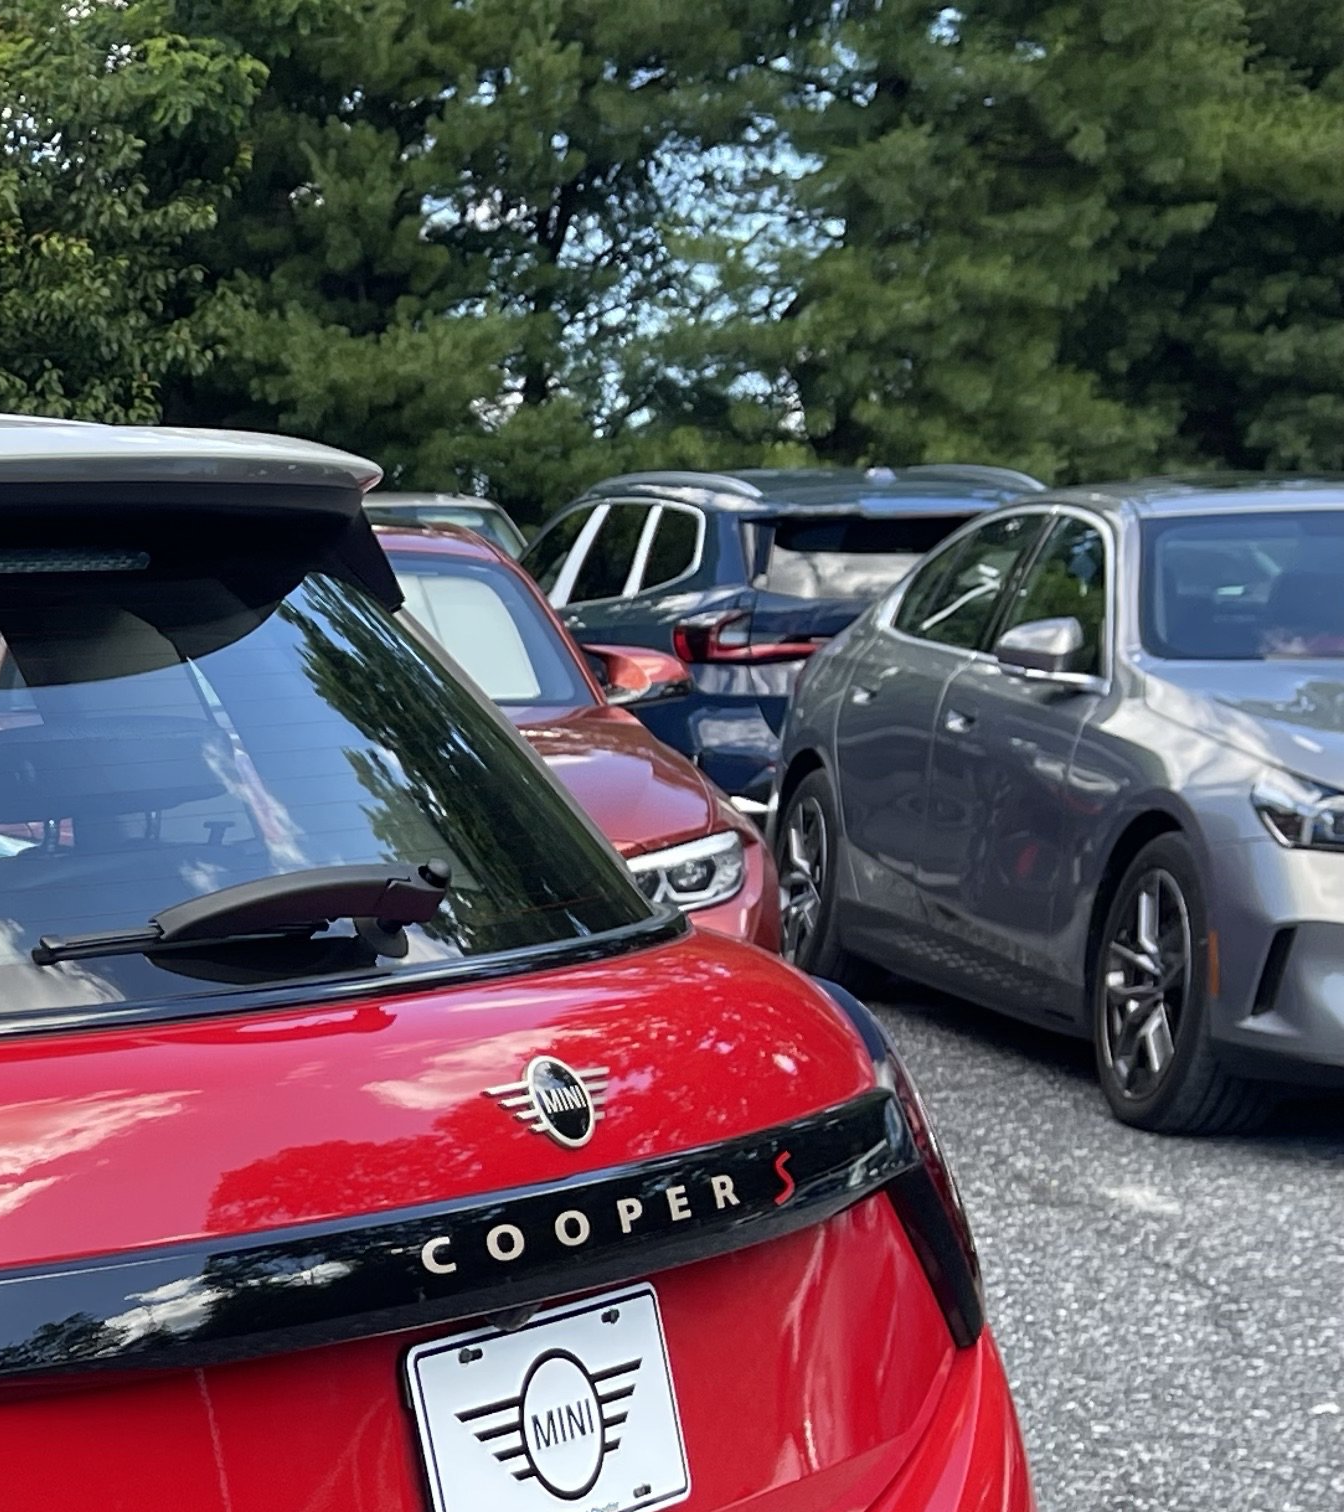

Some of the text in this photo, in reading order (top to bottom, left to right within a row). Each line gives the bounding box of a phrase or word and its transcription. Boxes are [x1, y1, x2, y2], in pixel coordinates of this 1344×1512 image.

[538, 1085, 587, 1114] MINI
[421, 1151, 795, 1274] COOPER S
[531, 1398, 594, 1450] MINI
